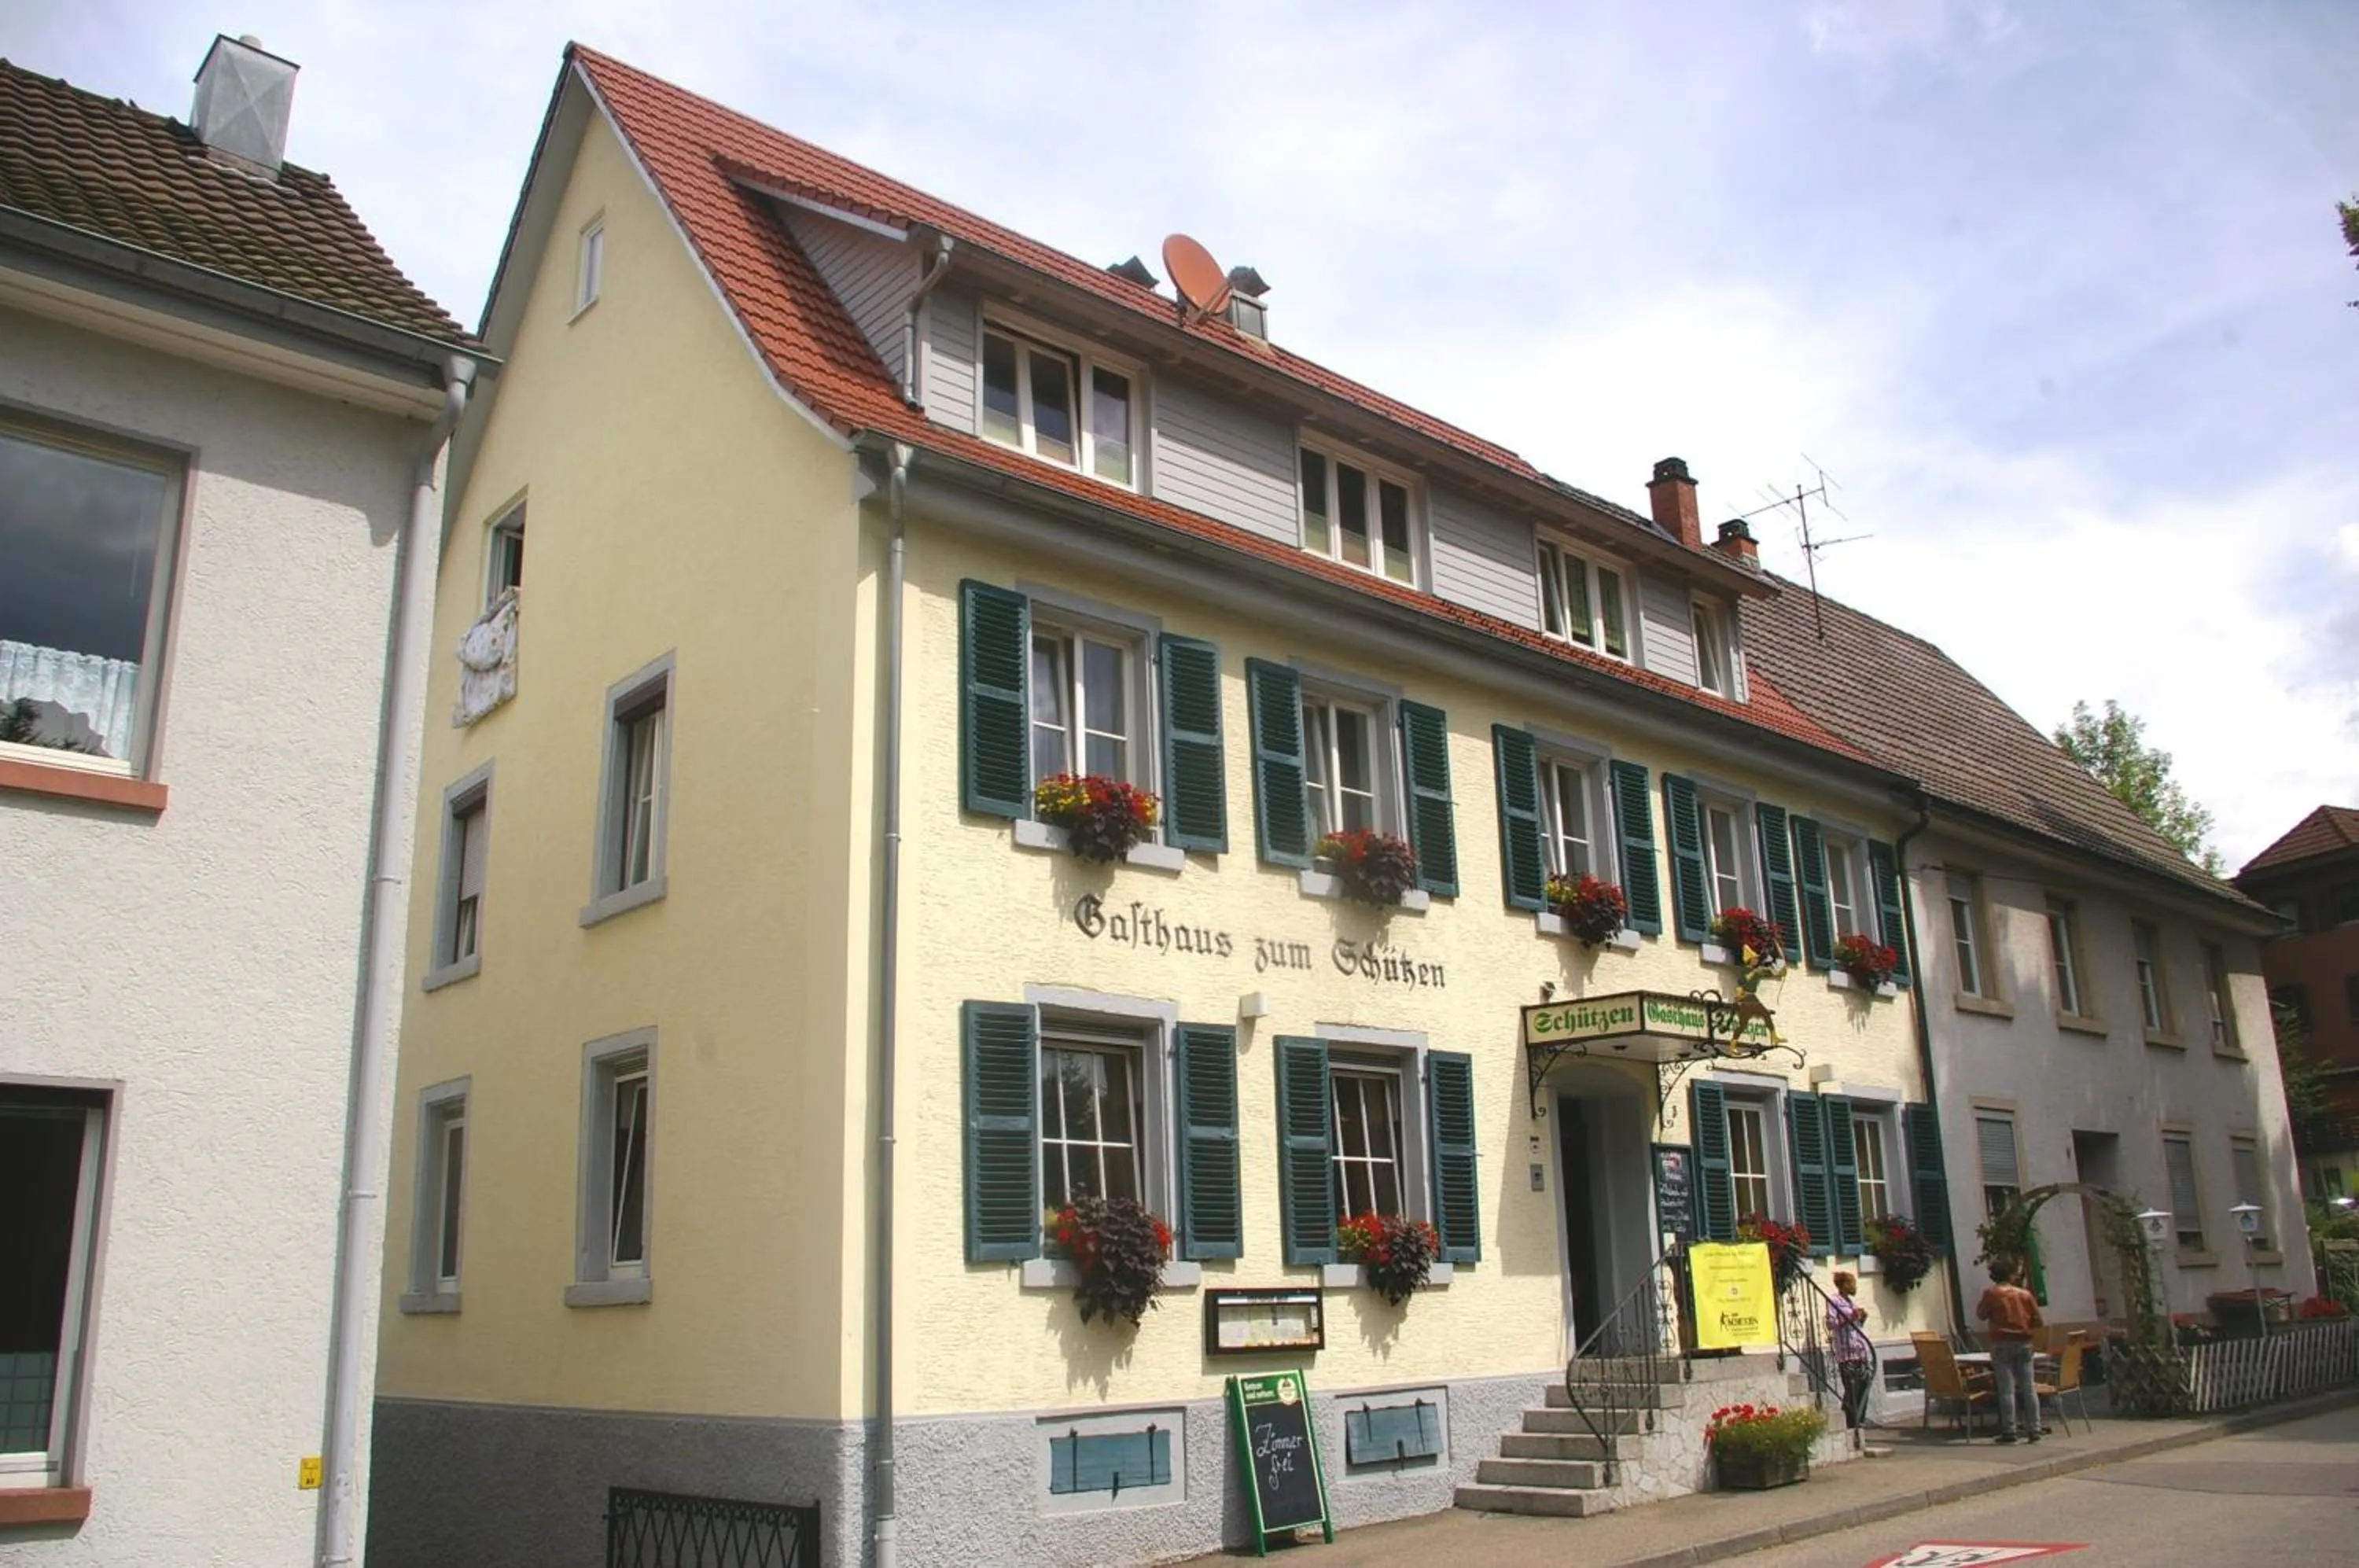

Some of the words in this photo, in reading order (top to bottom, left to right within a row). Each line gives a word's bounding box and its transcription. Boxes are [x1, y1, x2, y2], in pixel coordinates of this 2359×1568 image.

[1255, 937, 1312, 974] zum
[1332, 937, 1445, 992] Schützen
[1533, 1006, 1635, 1034] Schützen
